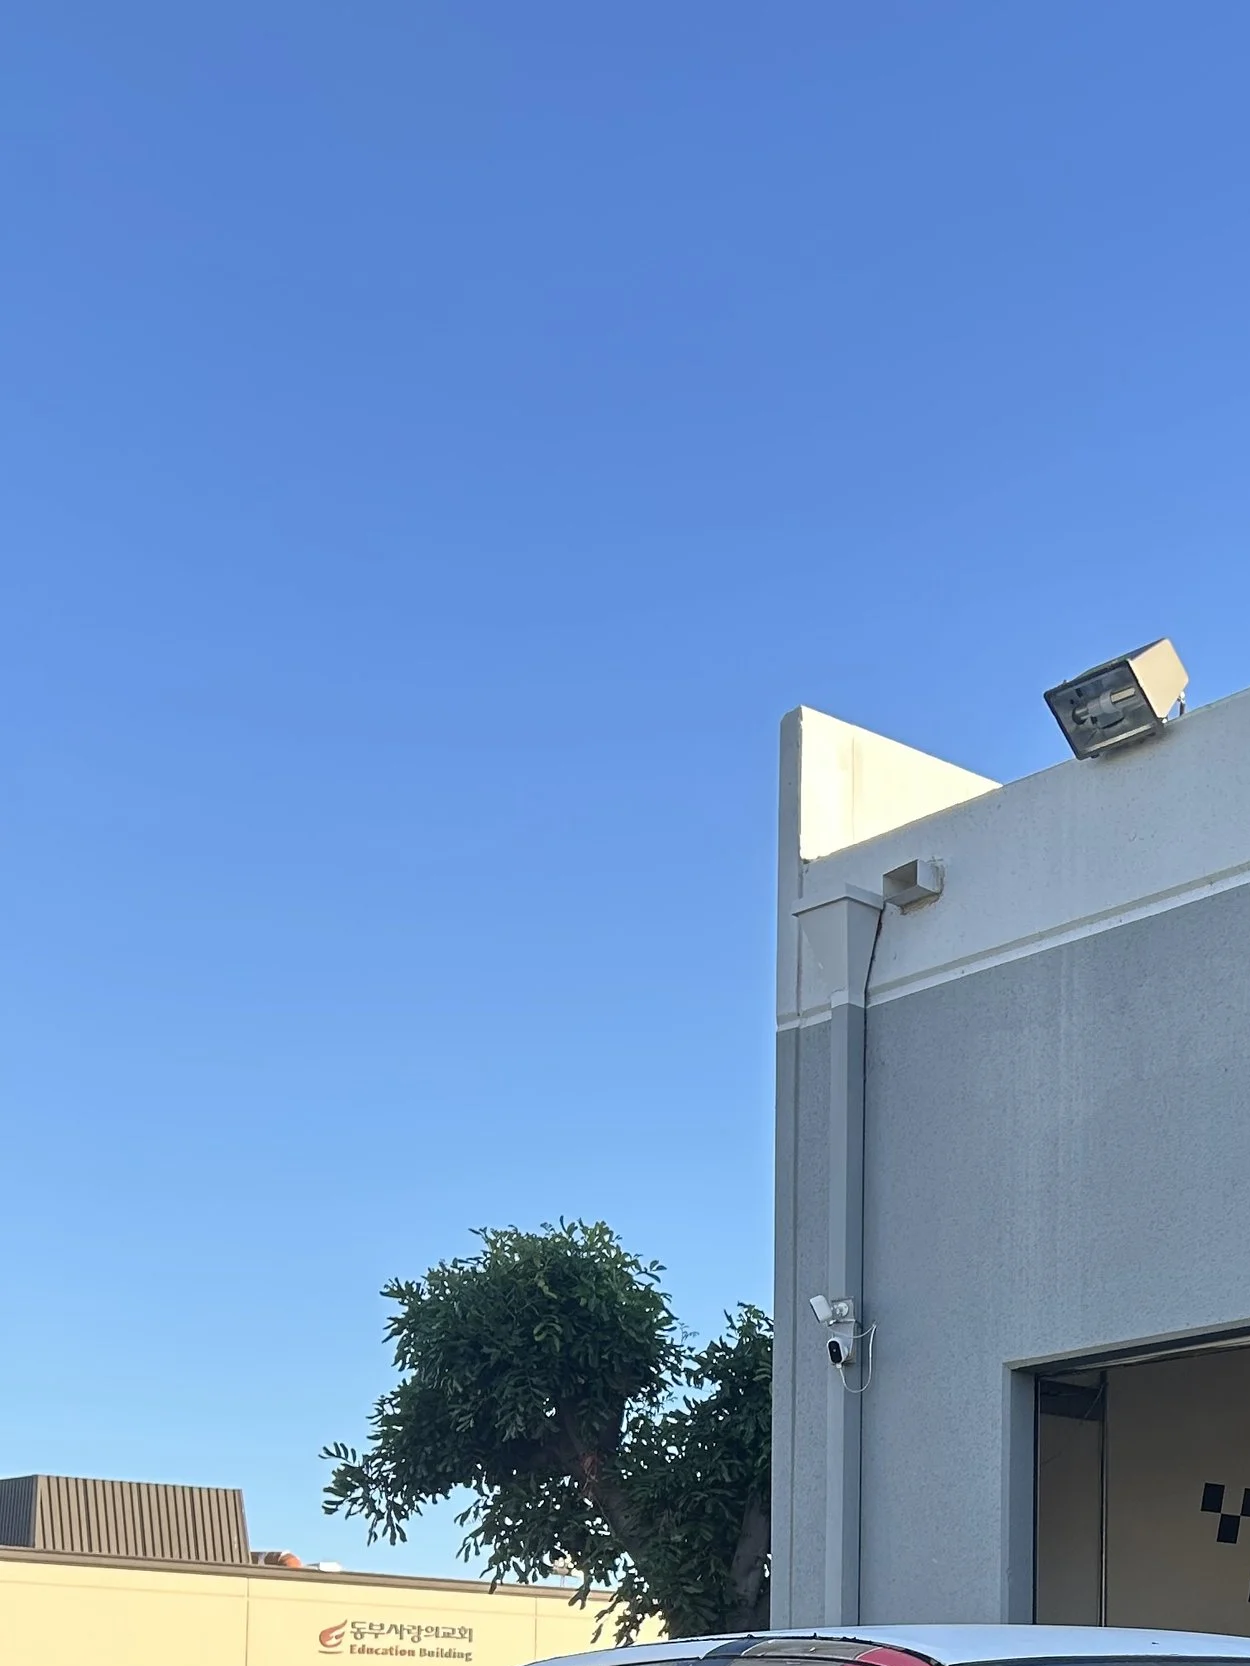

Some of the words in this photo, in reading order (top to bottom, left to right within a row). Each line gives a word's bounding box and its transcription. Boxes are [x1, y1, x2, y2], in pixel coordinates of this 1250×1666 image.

[350, 1621, 473, 1643] 동부사랑의교회
[350, 1644, 416, 1657] Education
[419, 1647, 473, 1662] Building
